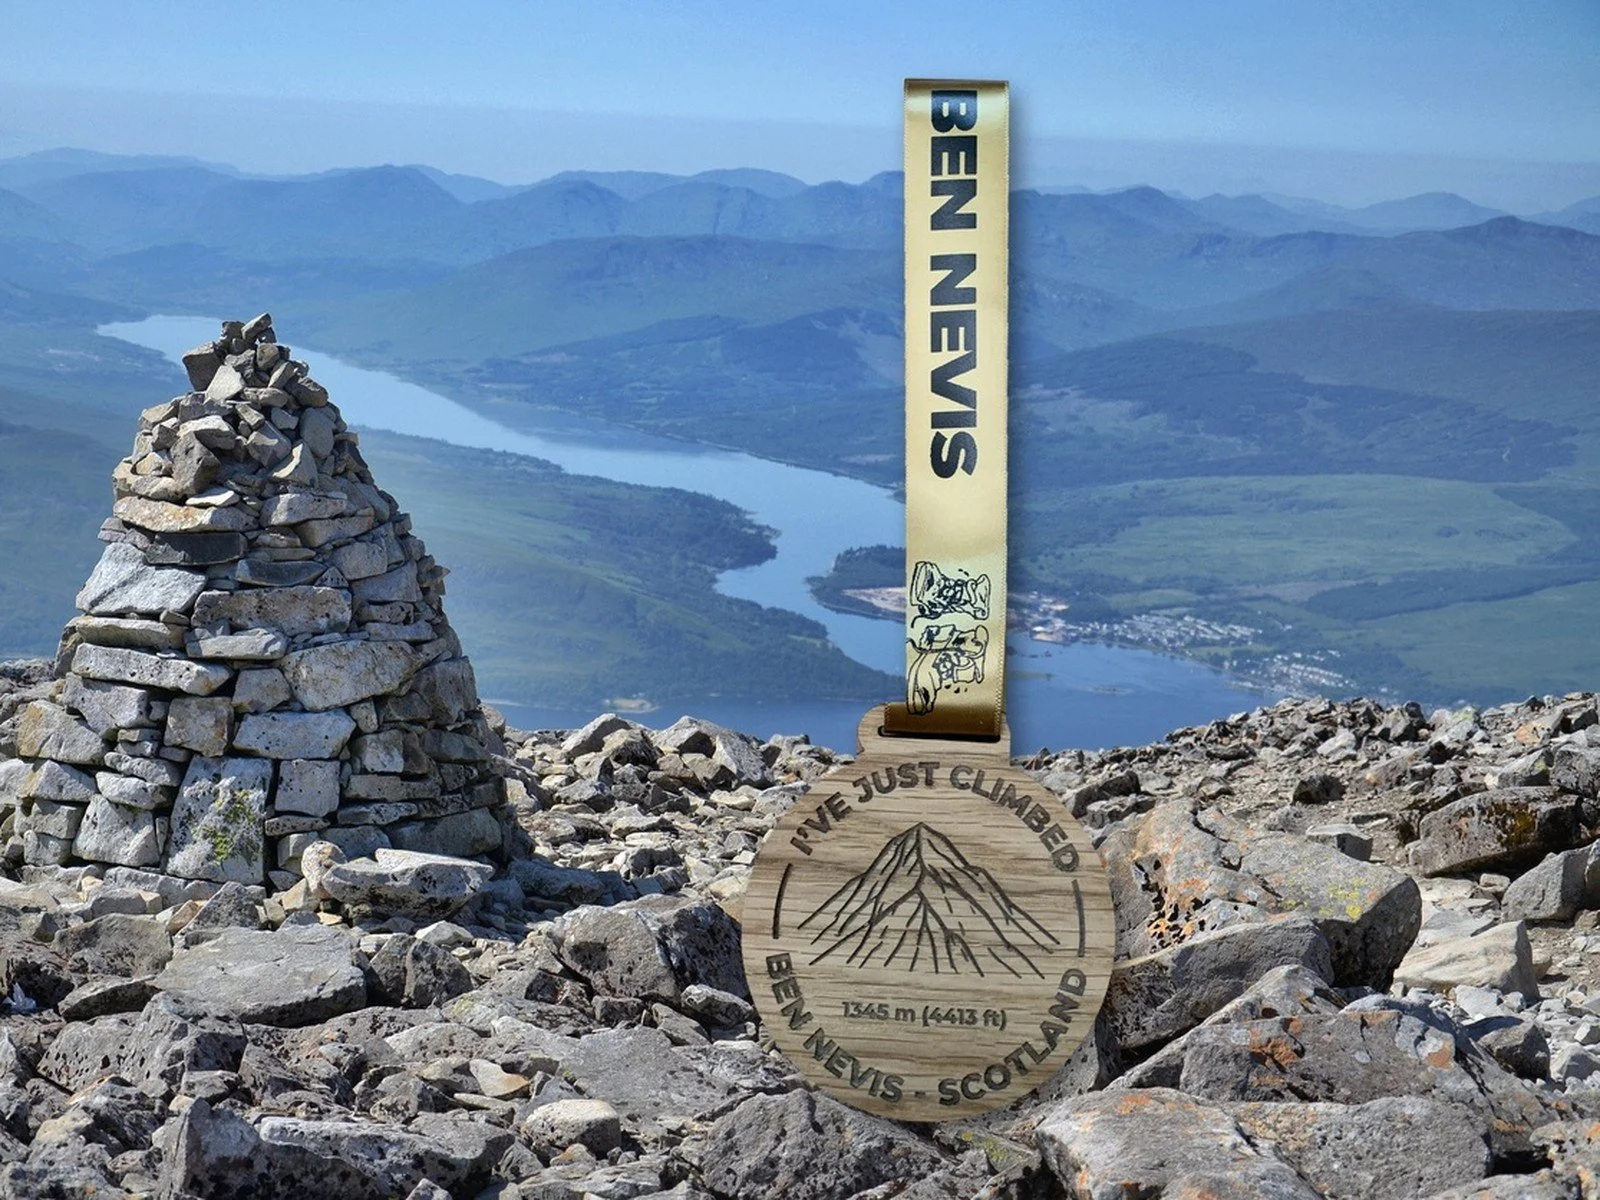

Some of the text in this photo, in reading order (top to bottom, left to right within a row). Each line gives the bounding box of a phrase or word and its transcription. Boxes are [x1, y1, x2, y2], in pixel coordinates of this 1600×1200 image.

[930, 90, 978, 479] BEN NEVIS
[790, 761, 1080, 872] I'VE JUST CLIMBED
[765, 952, 813, 1031] BEN
[802, 1027, 905, 1103] NEVIS
[938, 967, 1088, 1105] SCOTLAND
[841, 1001, 1007, 1031] 1345 m (4413 ft)
